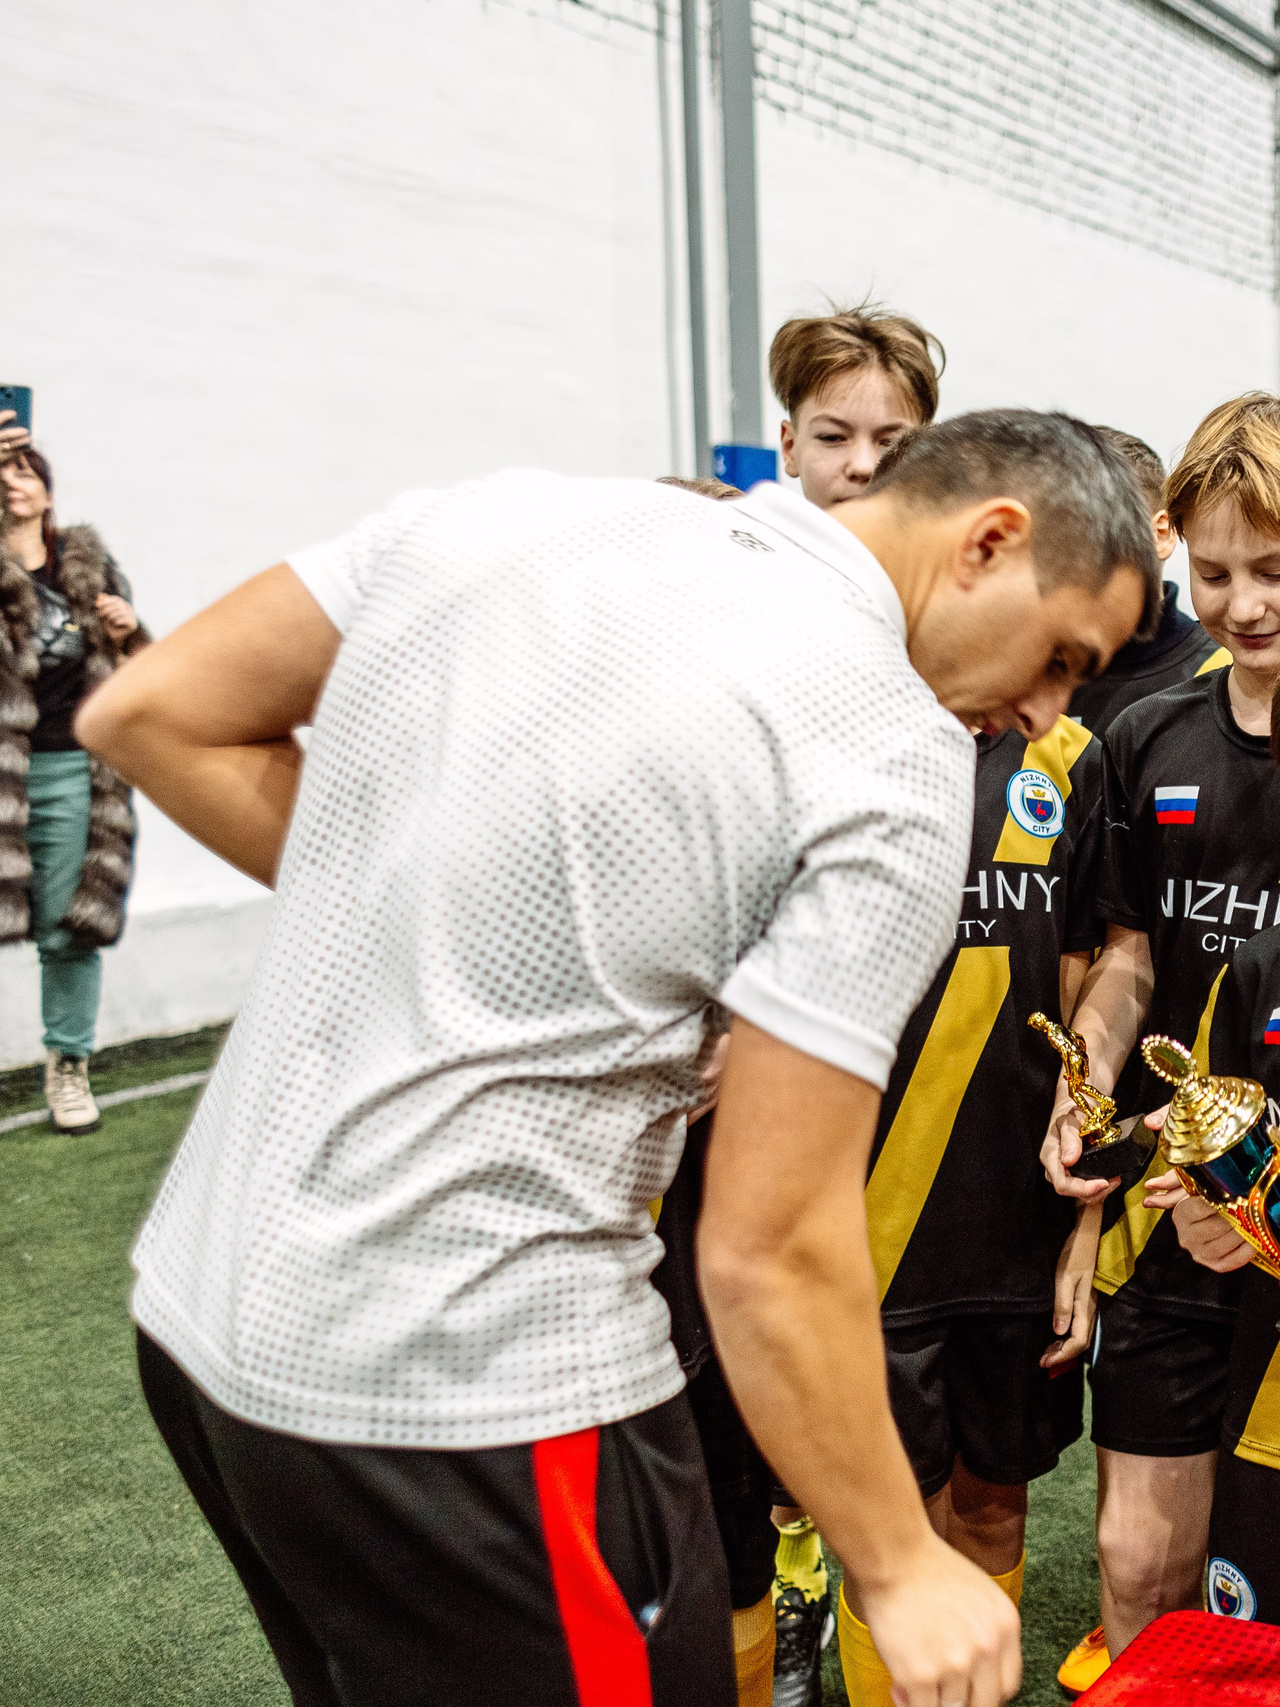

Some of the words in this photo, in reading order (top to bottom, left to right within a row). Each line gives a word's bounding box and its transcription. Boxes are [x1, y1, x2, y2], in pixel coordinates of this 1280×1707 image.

[1019, 773, 1052, 788] NIZHNY
[1032, 824, 1050, 834] CITY
[1214, 1564, 1242, 1583] NIZHNY
